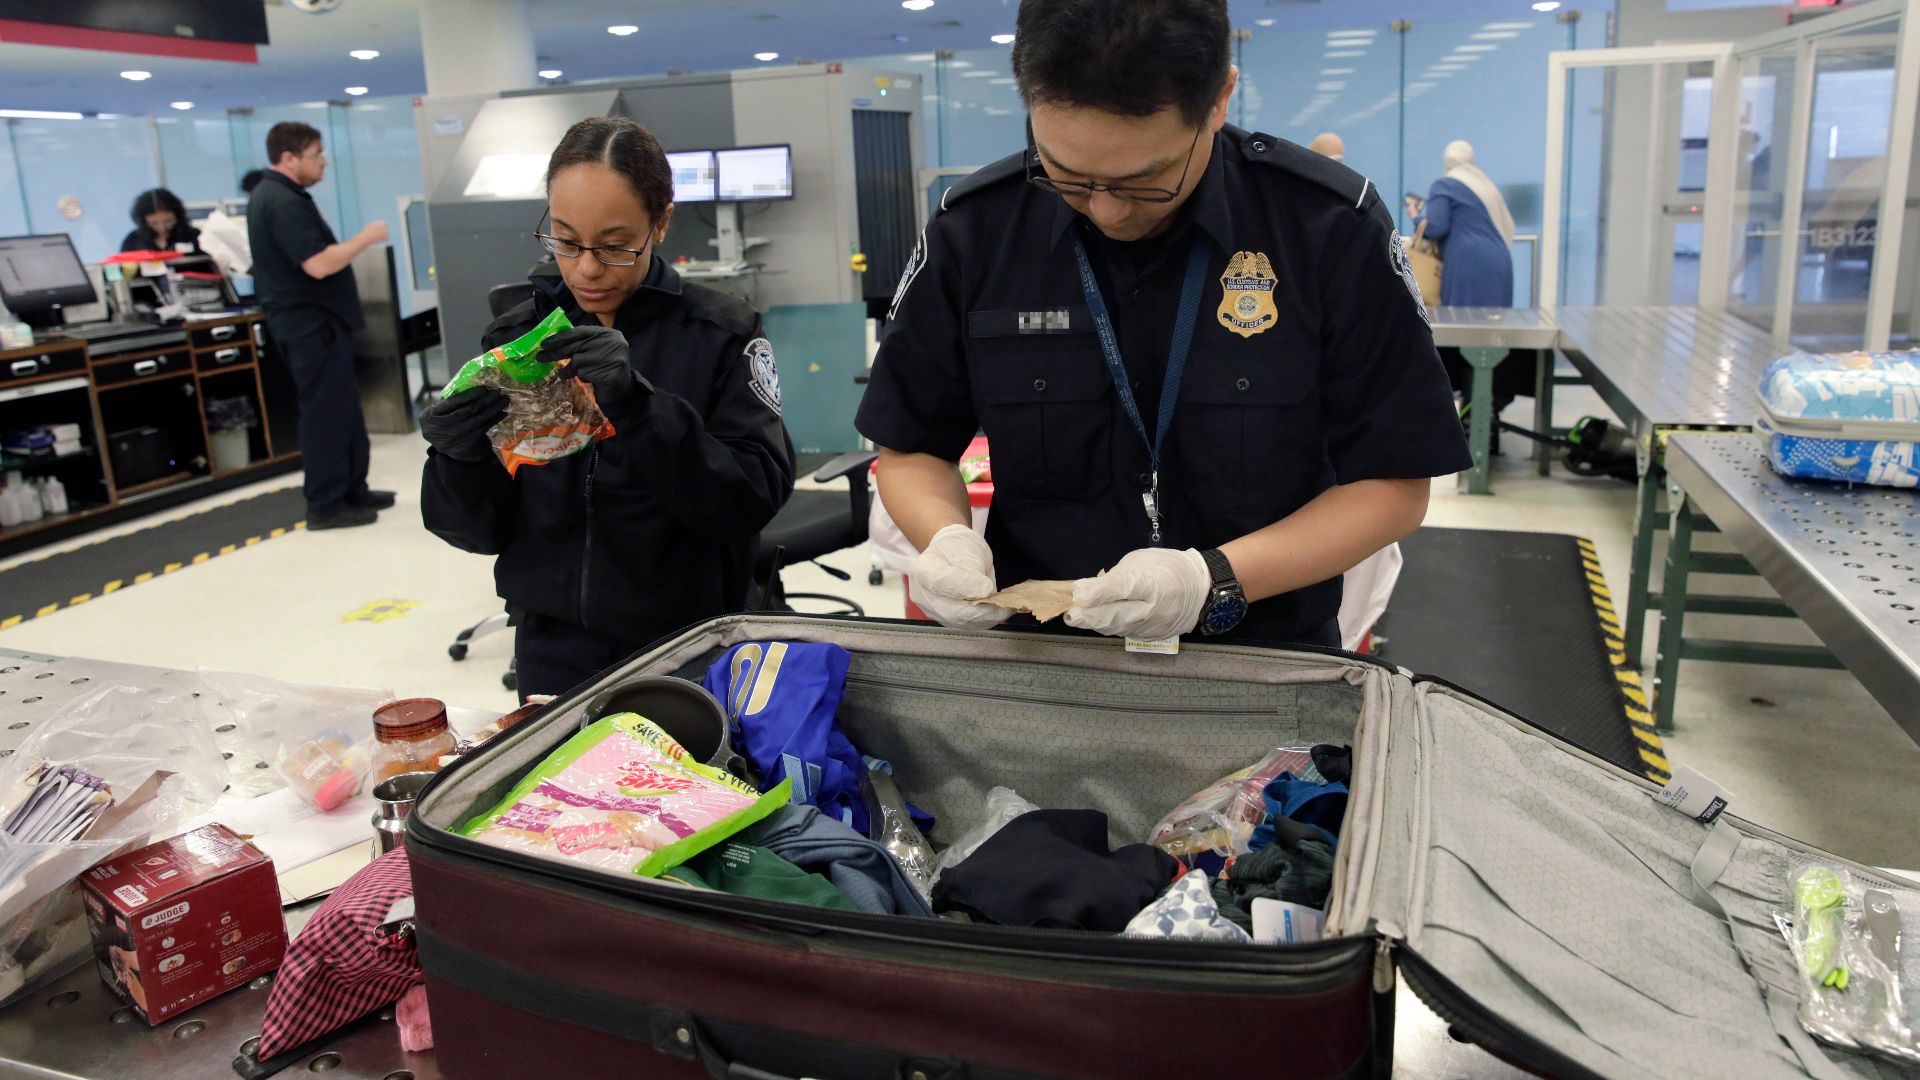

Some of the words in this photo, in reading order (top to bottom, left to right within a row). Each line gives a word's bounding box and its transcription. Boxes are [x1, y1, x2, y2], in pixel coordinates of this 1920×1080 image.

[1260, 279, 1271, 287] AND
[1231, 318, 1264, 329] OFFICER
[632, 722, 662, 744] SAVE
[154, 904, 185, 923] JUDGE
